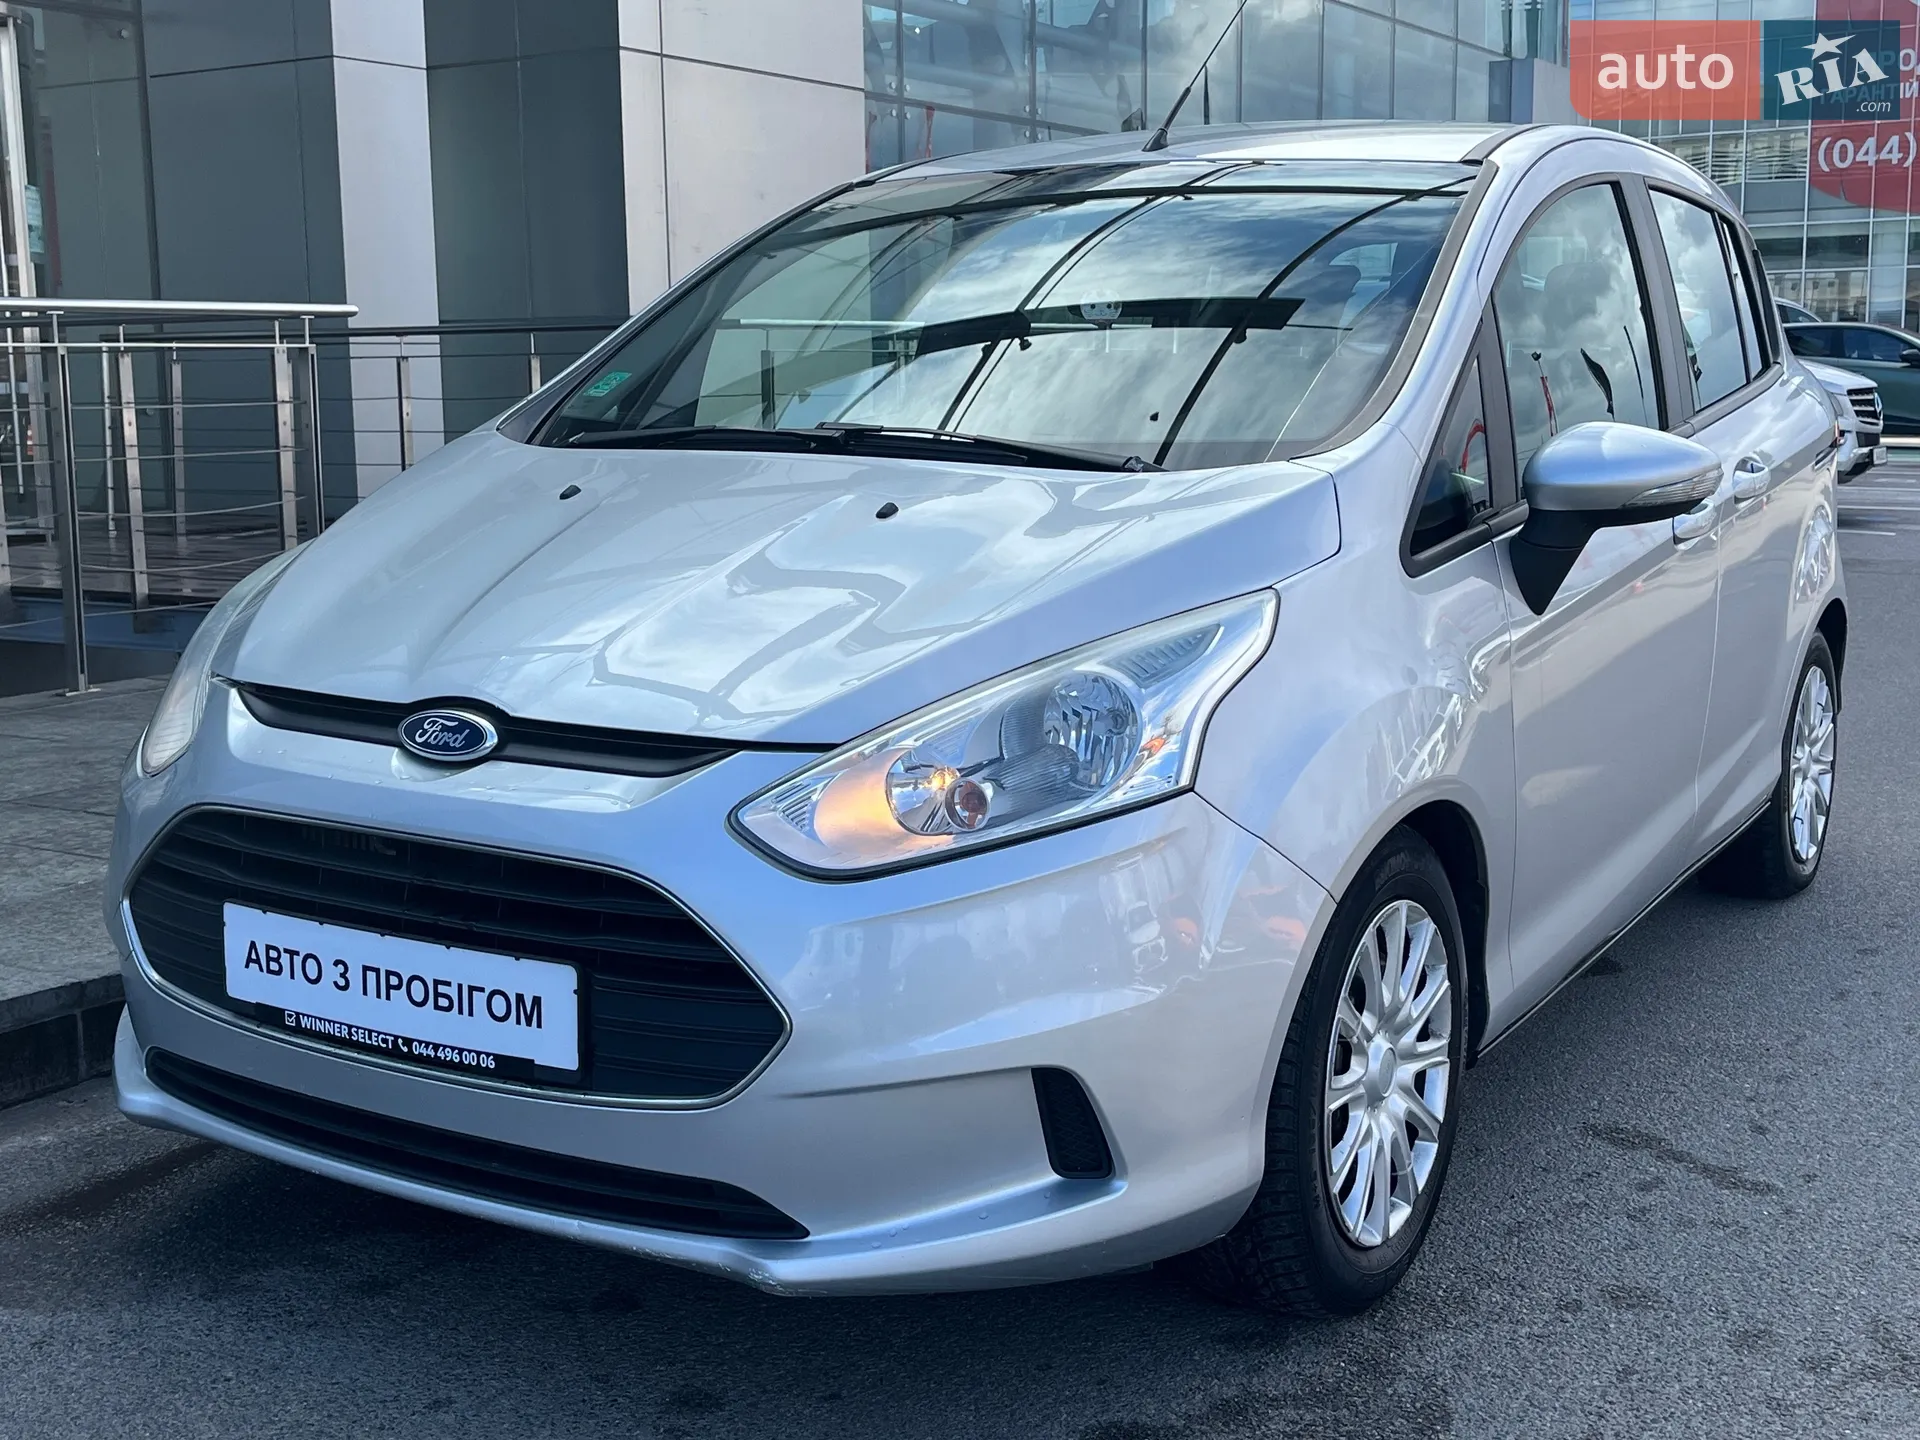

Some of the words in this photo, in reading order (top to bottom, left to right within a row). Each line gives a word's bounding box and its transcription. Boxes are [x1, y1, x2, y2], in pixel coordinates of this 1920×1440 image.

[1818, 131, 1917, 172] (044)
[415, 717, 470, 748] Ford
[244, 940, 323, 986] АВТО
[361, 963, 543, 1030] ПРОБІГОМ
[299, 1014, 349, 1039] WINNER
[351, 1027, 395, 1049] SELECT
[412, 1041, 436, 1058] 044
[436, 1046, 460, 1063] 496
[462, 1050, 477, 1066] 00
[480, 1053, 495, 1069] 06
